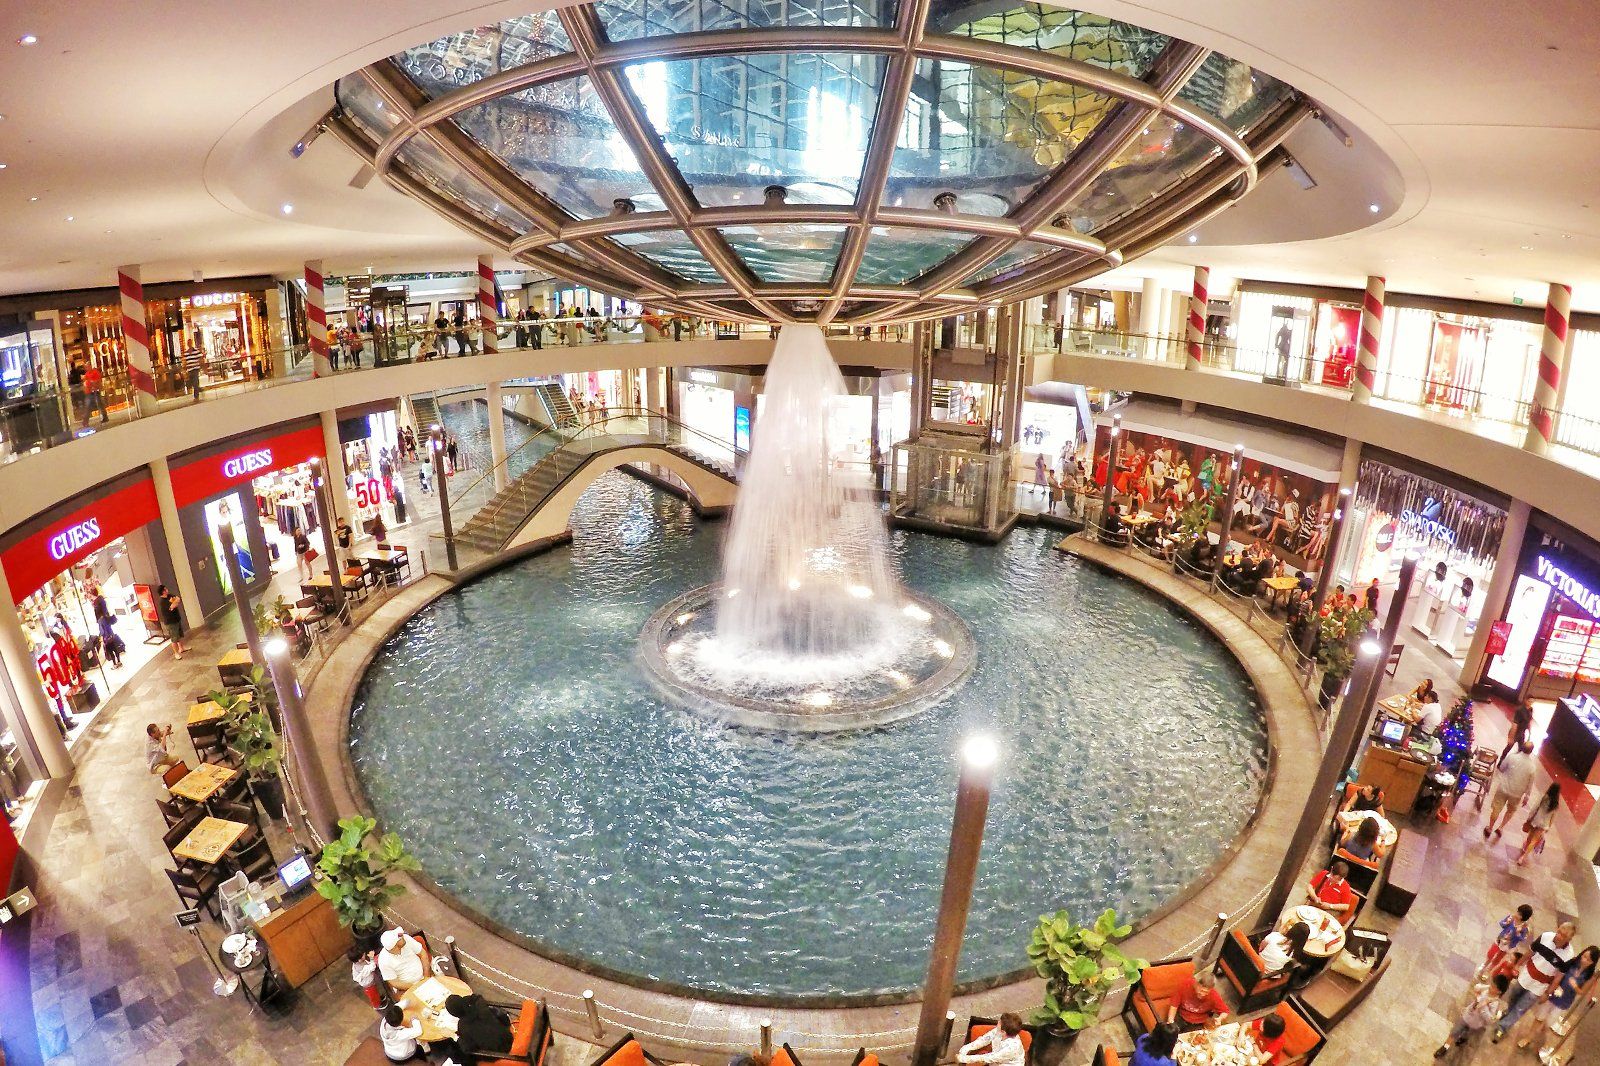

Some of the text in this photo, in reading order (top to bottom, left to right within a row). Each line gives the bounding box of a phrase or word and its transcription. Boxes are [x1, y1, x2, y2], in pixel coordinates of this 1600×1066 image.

[193, 293, 237, 306] GUCCI
[224, 448, 273, 478] GUESS
[51, 517, 101, 560] GUESS
[1401, 509, 1456, 545] SWAROVSKI
